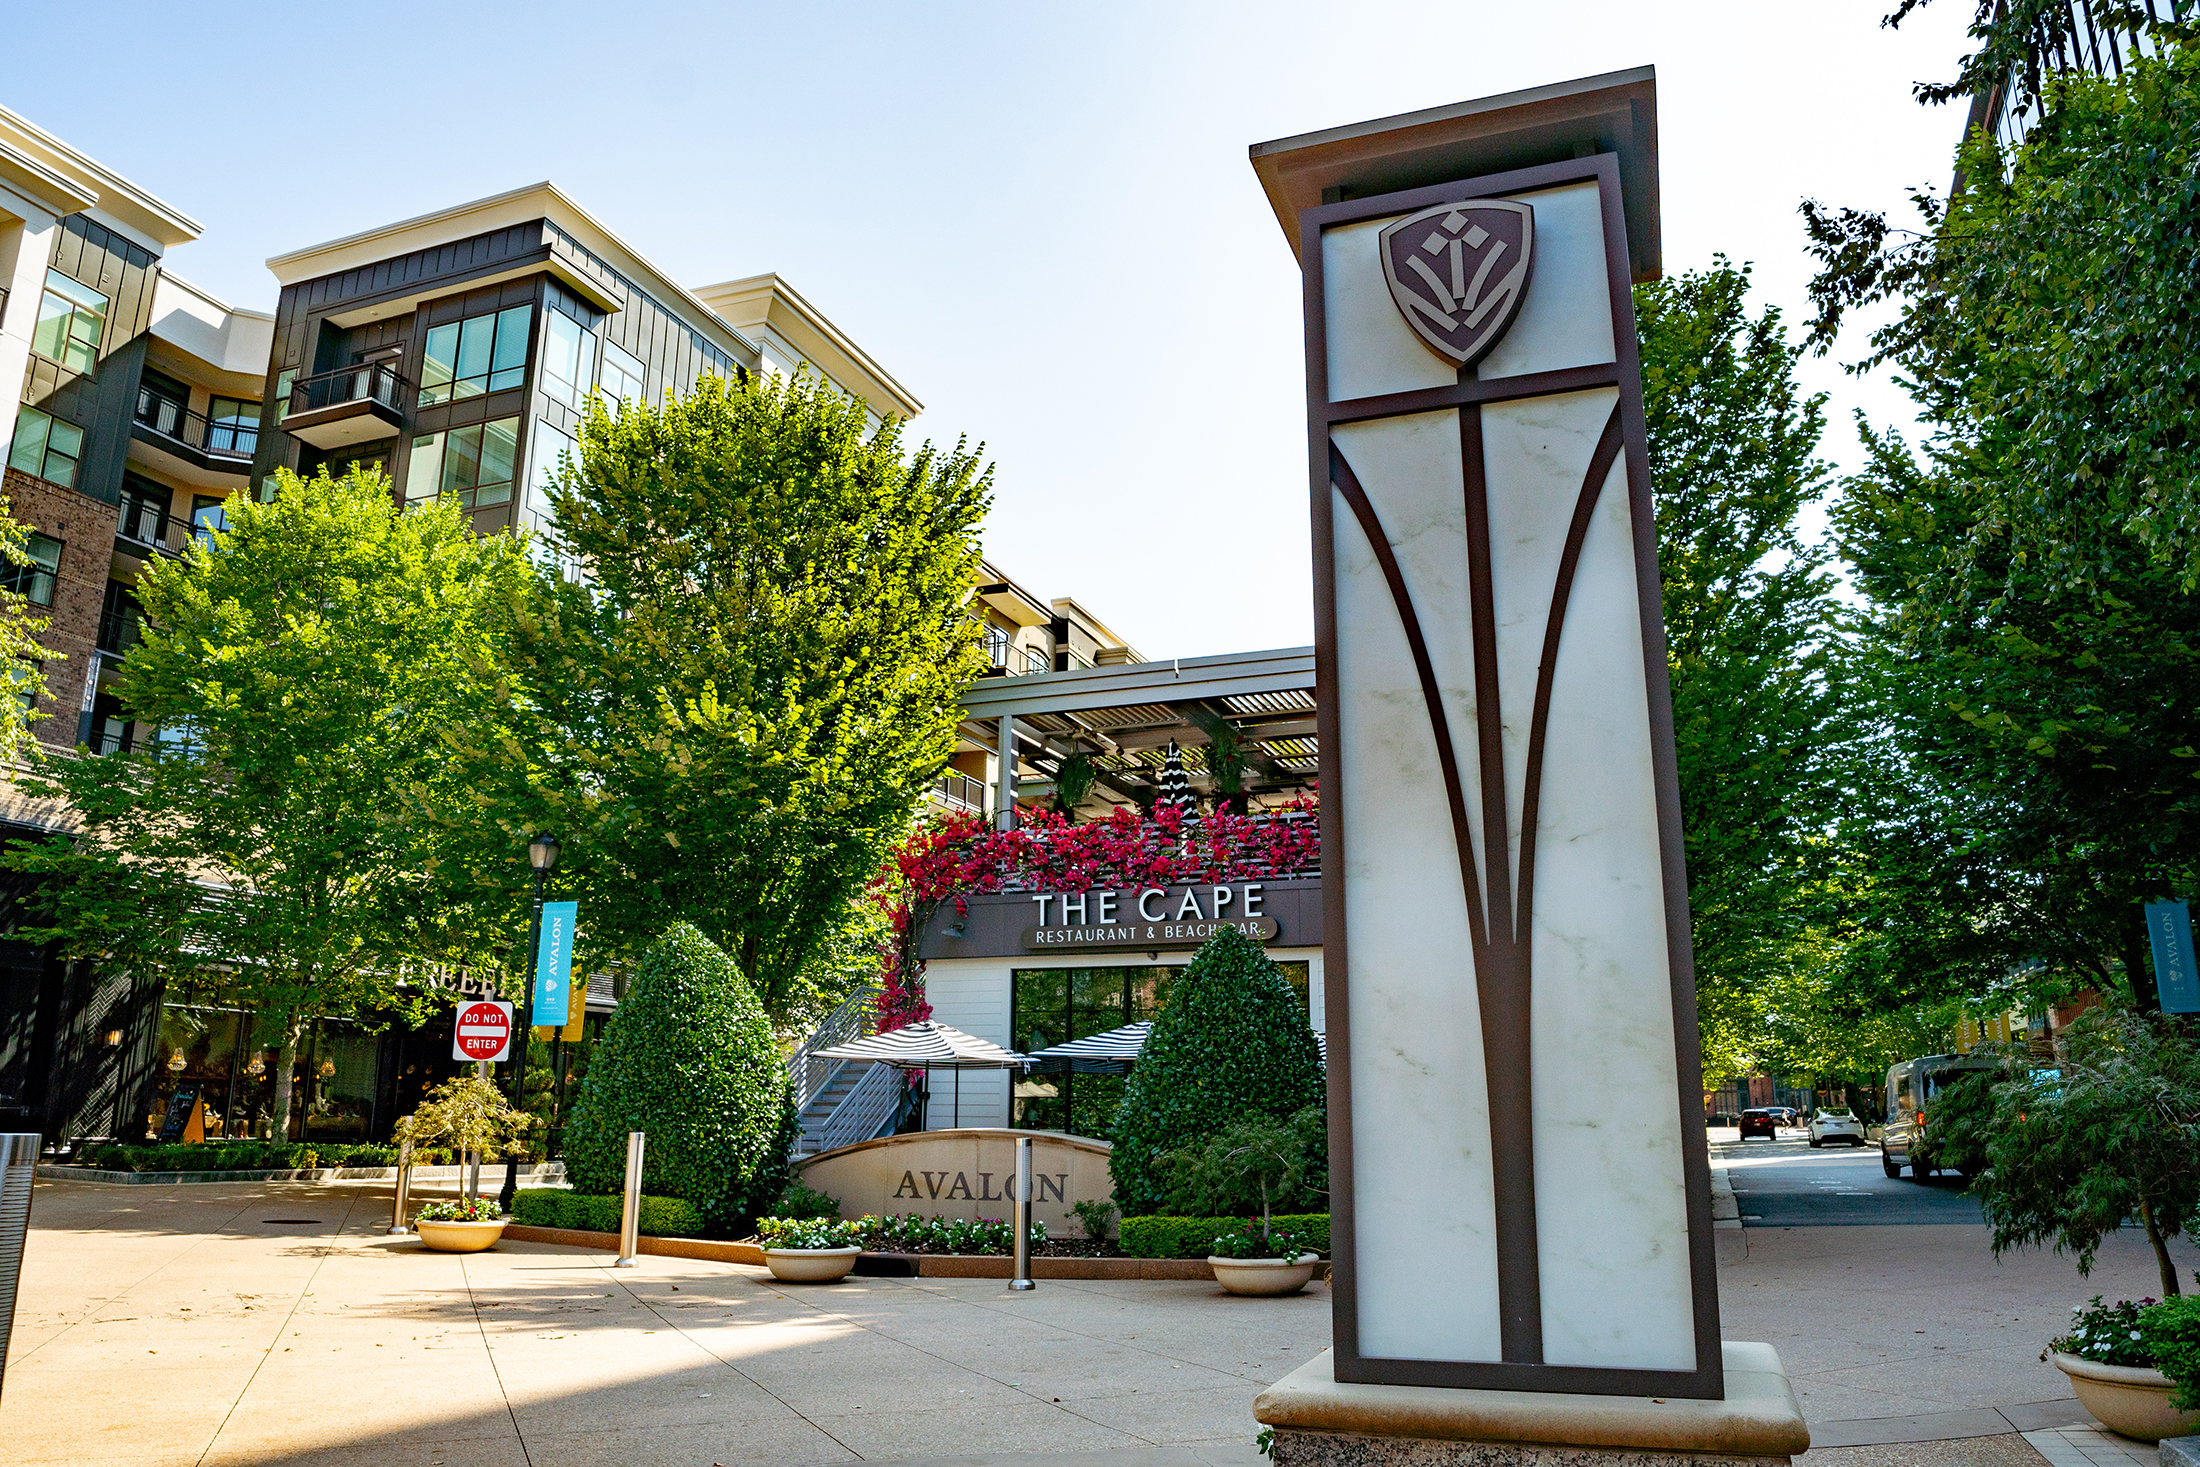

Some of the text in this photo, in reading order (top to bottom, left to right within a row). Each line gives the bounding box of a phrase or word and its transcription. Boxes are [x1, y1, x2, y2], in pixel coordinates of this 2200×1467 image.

[1032, 884, 1263, 927] THE CAPE
[548, 916, 562, 977] AVALON
[1036, 921, 1259, 944] RESTAURANT & BEACH AR
[2161, 912, 2180, 967] AVALON
[465, 1013, 504, 1024] DO NOT
[466, 1039, 498, 1049] ENTER
